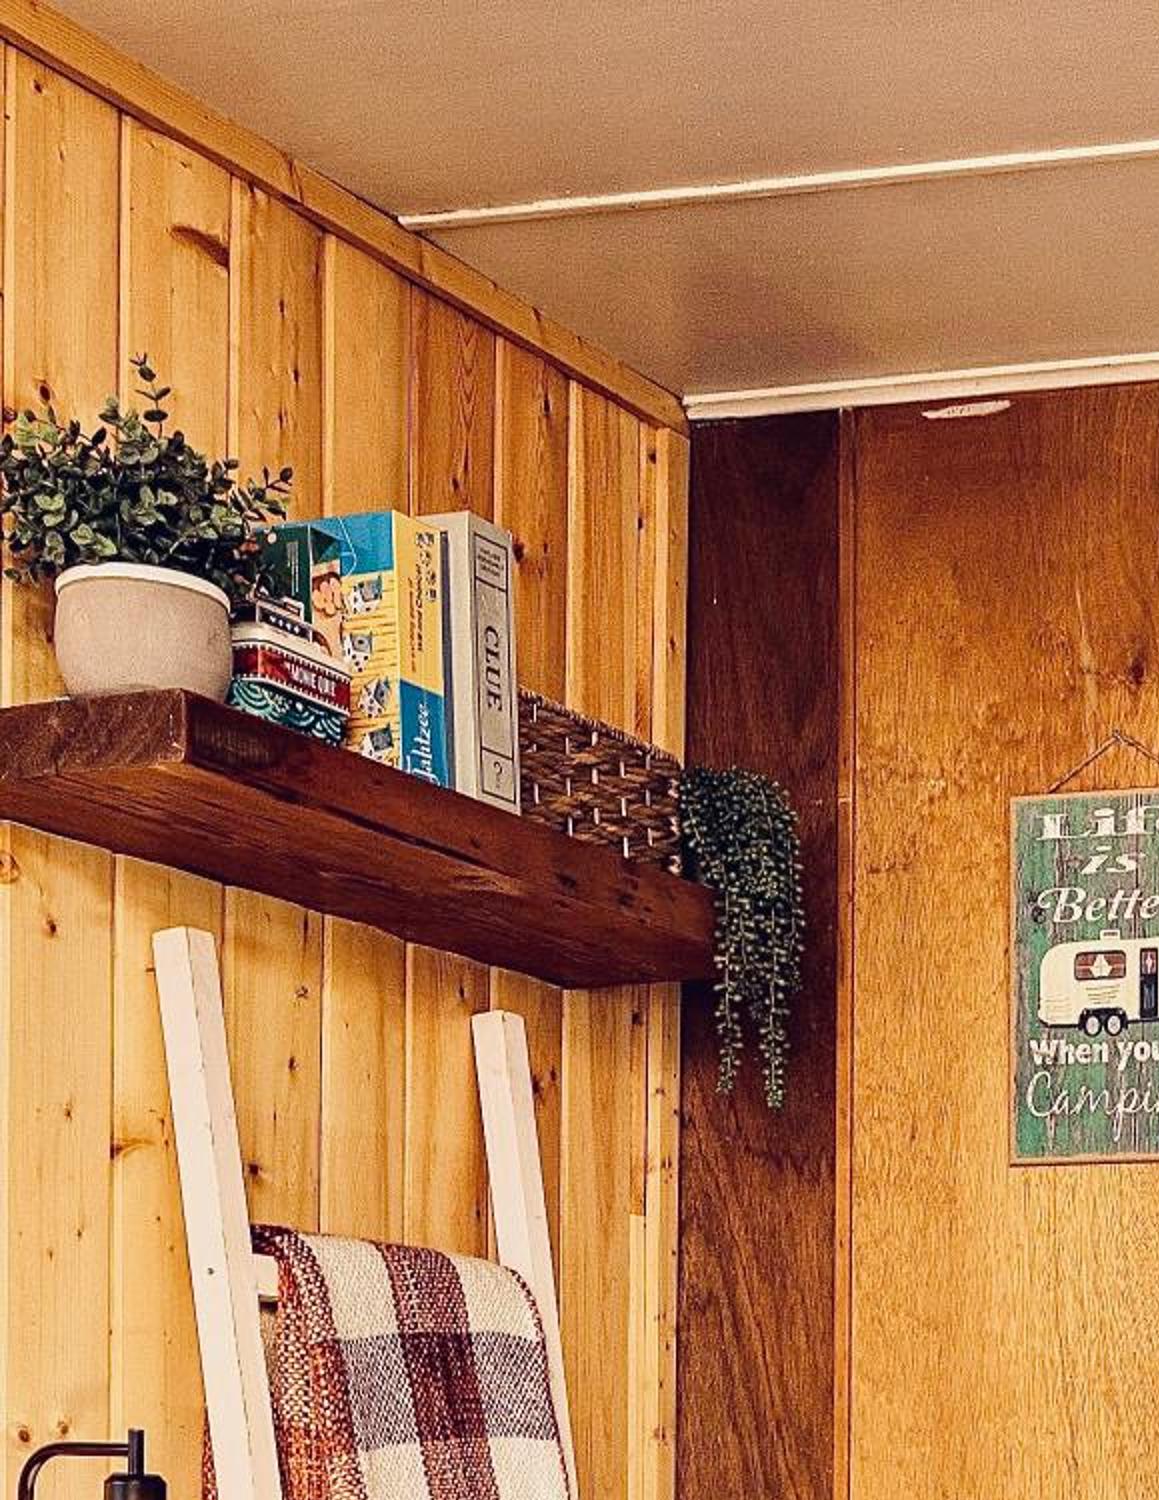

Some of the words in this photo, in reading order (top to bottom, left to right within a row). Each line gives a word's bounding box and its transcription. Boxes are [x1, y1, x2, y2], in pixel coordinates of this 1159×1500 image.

[484, 625, 502, 711] CLUE
[406, 702, 441, 787] Yahtzee
[1080, 845, 1146, 875] is
[1030, 1037, 1109, 1066] When
